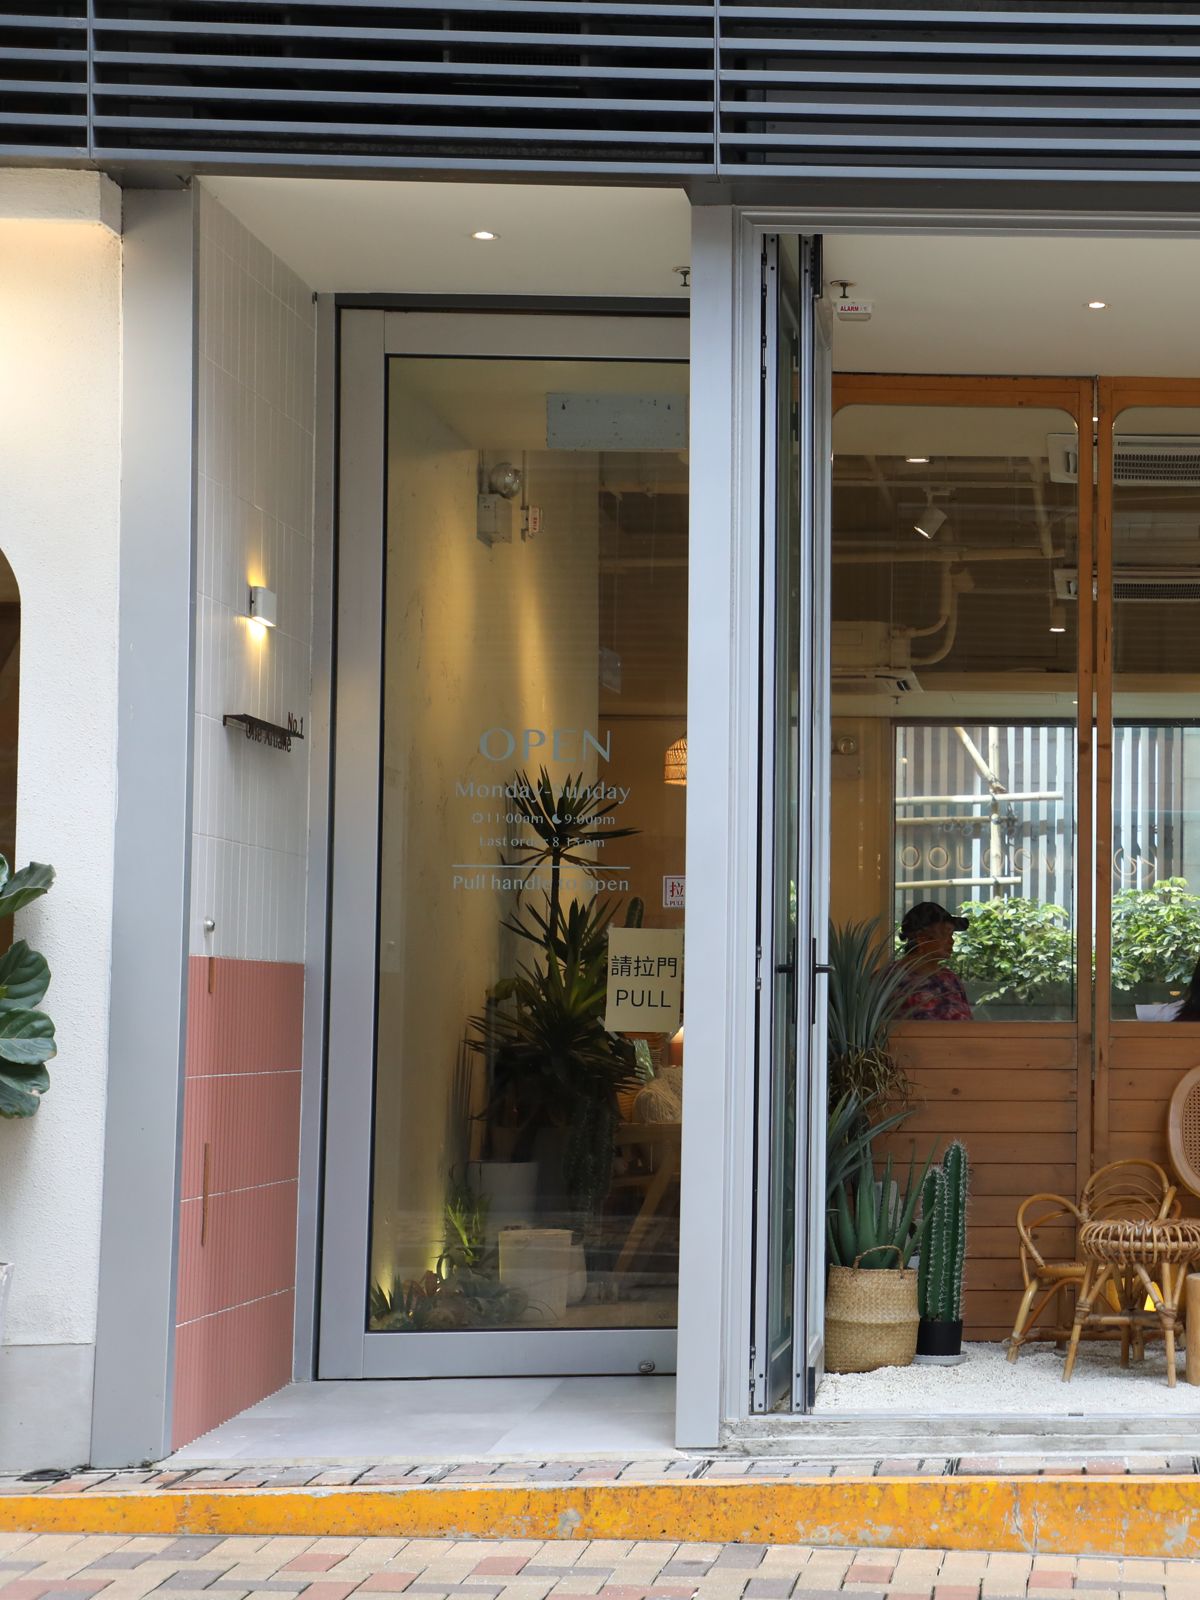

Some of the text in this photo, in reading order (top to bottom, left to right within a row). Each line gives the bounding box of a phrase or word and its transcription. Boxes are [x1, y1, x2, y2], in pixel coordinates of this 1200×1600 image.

[479, 727, 612, 763] OPEN
[510, 835, 549, 848] ordr
[453, 875, 485, 890] Pull
[491, 874, 552, 891] handle
[611, 955, 678, 978] 請拉門
[616, 989, 671, 1008] PULL
